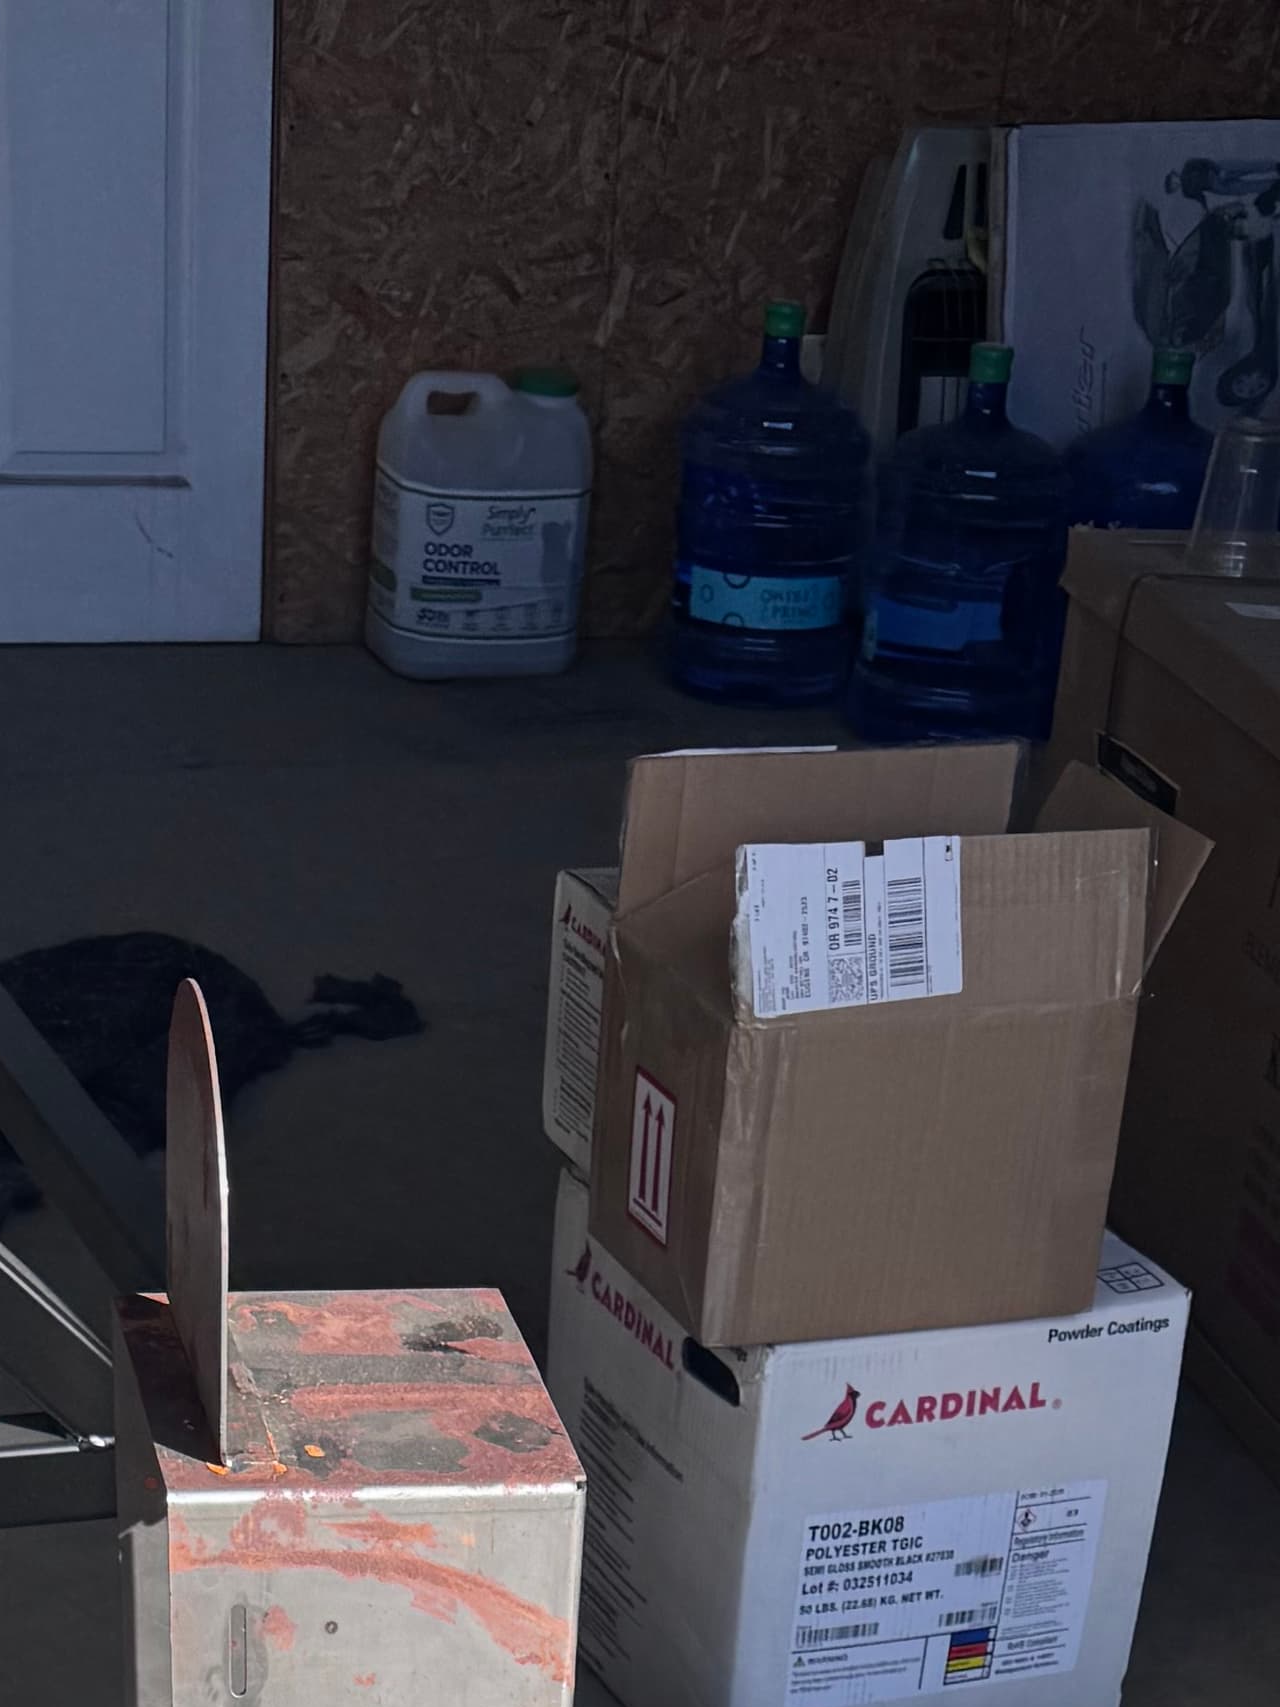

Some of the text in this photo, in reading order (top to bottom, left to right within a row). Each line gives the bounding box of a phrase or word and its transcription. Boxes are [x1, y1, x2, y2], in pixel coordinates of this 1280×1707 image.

[424, 543, 473, 557] ODOR
[423, 559, 501, 575] CONTROL
[867, 933, 878, 1001] UPS GROUND
[590, 1271, 675, 1372] CARDINAL
[1048, 1316, 1170, 1343] Powder Coatings
[864, 1380, 1047, 1430] CARDINAL
[808, 1515, 905, 1542] T002-BK08
[805, 1536, 923, 1562] POLYESTER TGIC
[1011, 1549, 1050, 1563] Danger
[827, 1560, 855, 1574] GLOSS
[856, 1557, 894, 1572] SMOOTH
[896, 1553, 923, 1567] BLACK
[802, 1572, 913, 1595] Lot #: 032511034
[799, 1604, 813, 1615] 50
[814, 1601, 839, 1614] LBS.
[879, 1594, 899, 1606] KG.
[901, 1591, 922, 1604] NET
[924, 1589, 944, 1602] WT.
